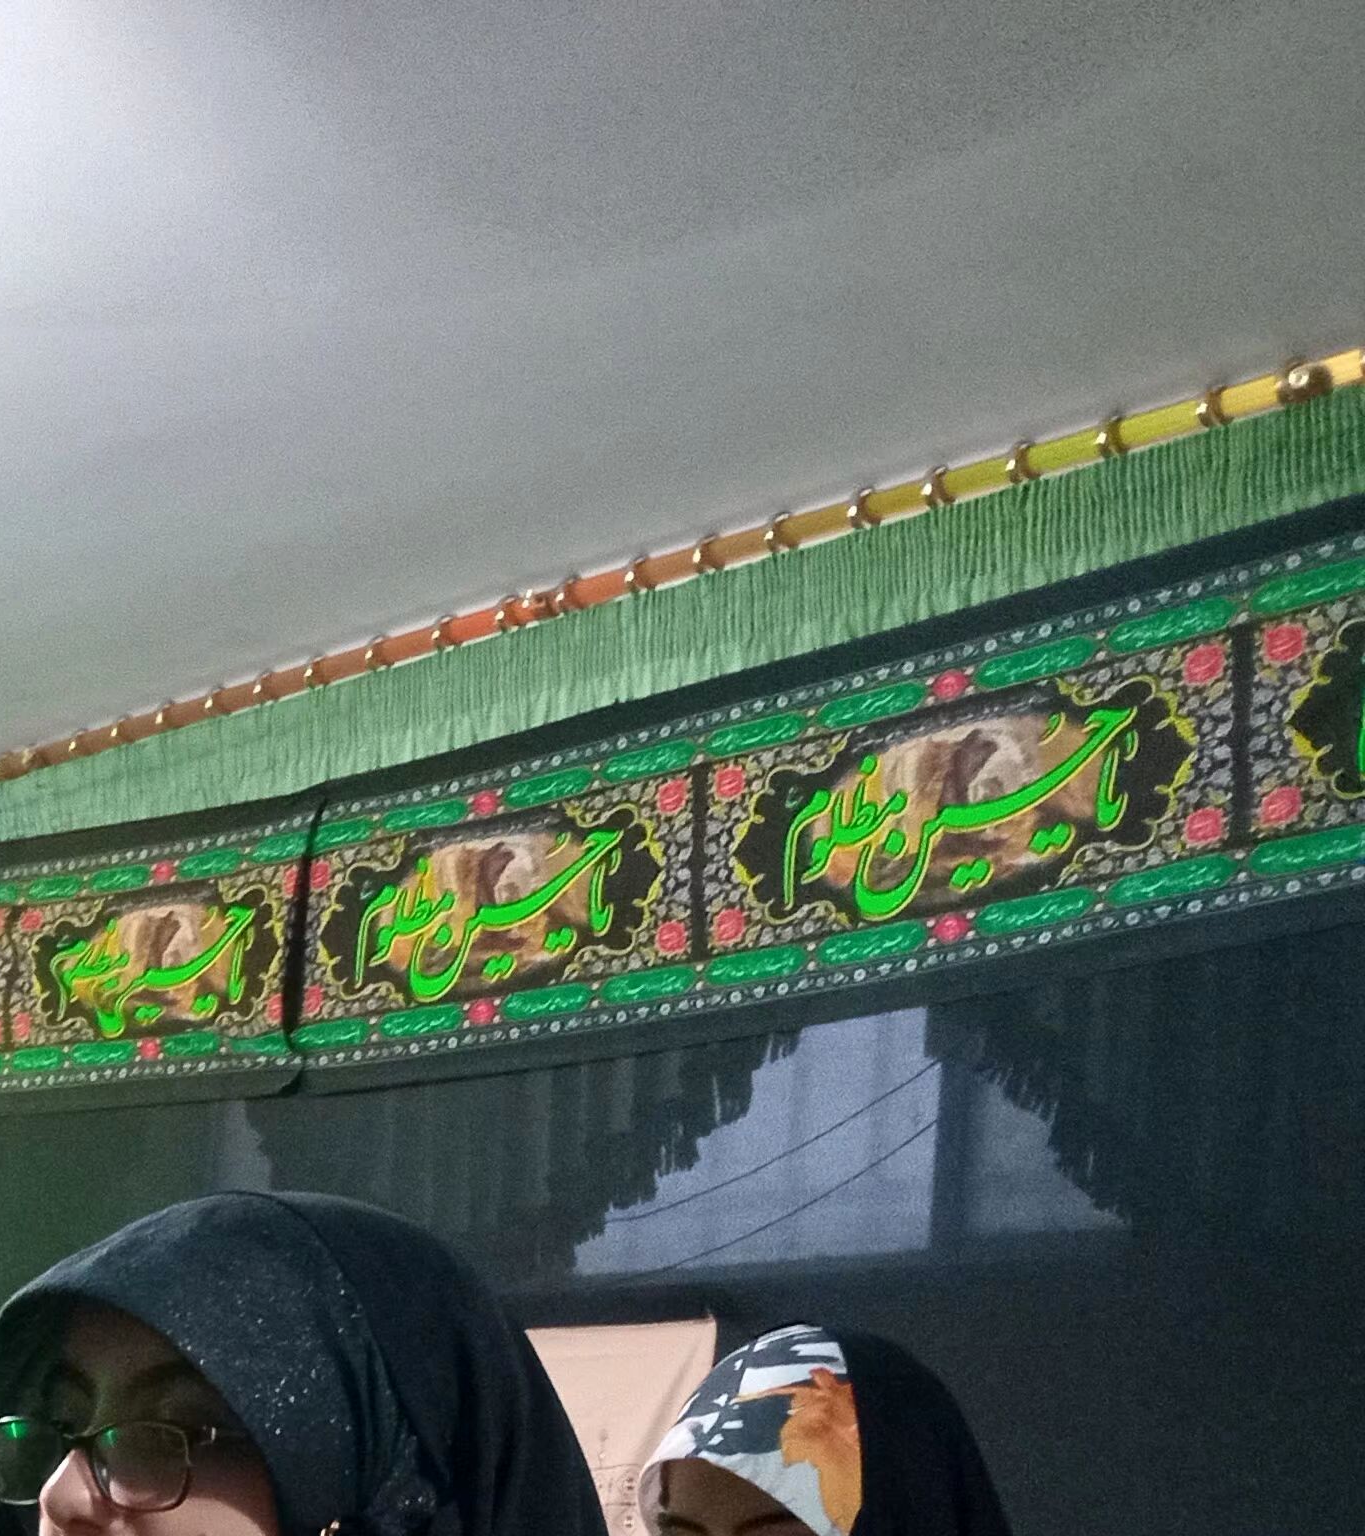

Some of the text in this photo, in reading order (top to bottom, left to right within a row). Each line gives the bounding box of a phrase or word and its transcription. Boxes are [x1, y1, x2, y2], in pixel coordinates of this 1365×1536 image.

[783, 753, 909, 910] مظلوم
[855, 706, 1139, 921] حسین
[50, 918, 130, 1022] مظلوم
[97, 904, 256, 1039] حسین
[355, 856, 456, 989] مظلوم
[409, 829, 623, 1003] حسین
